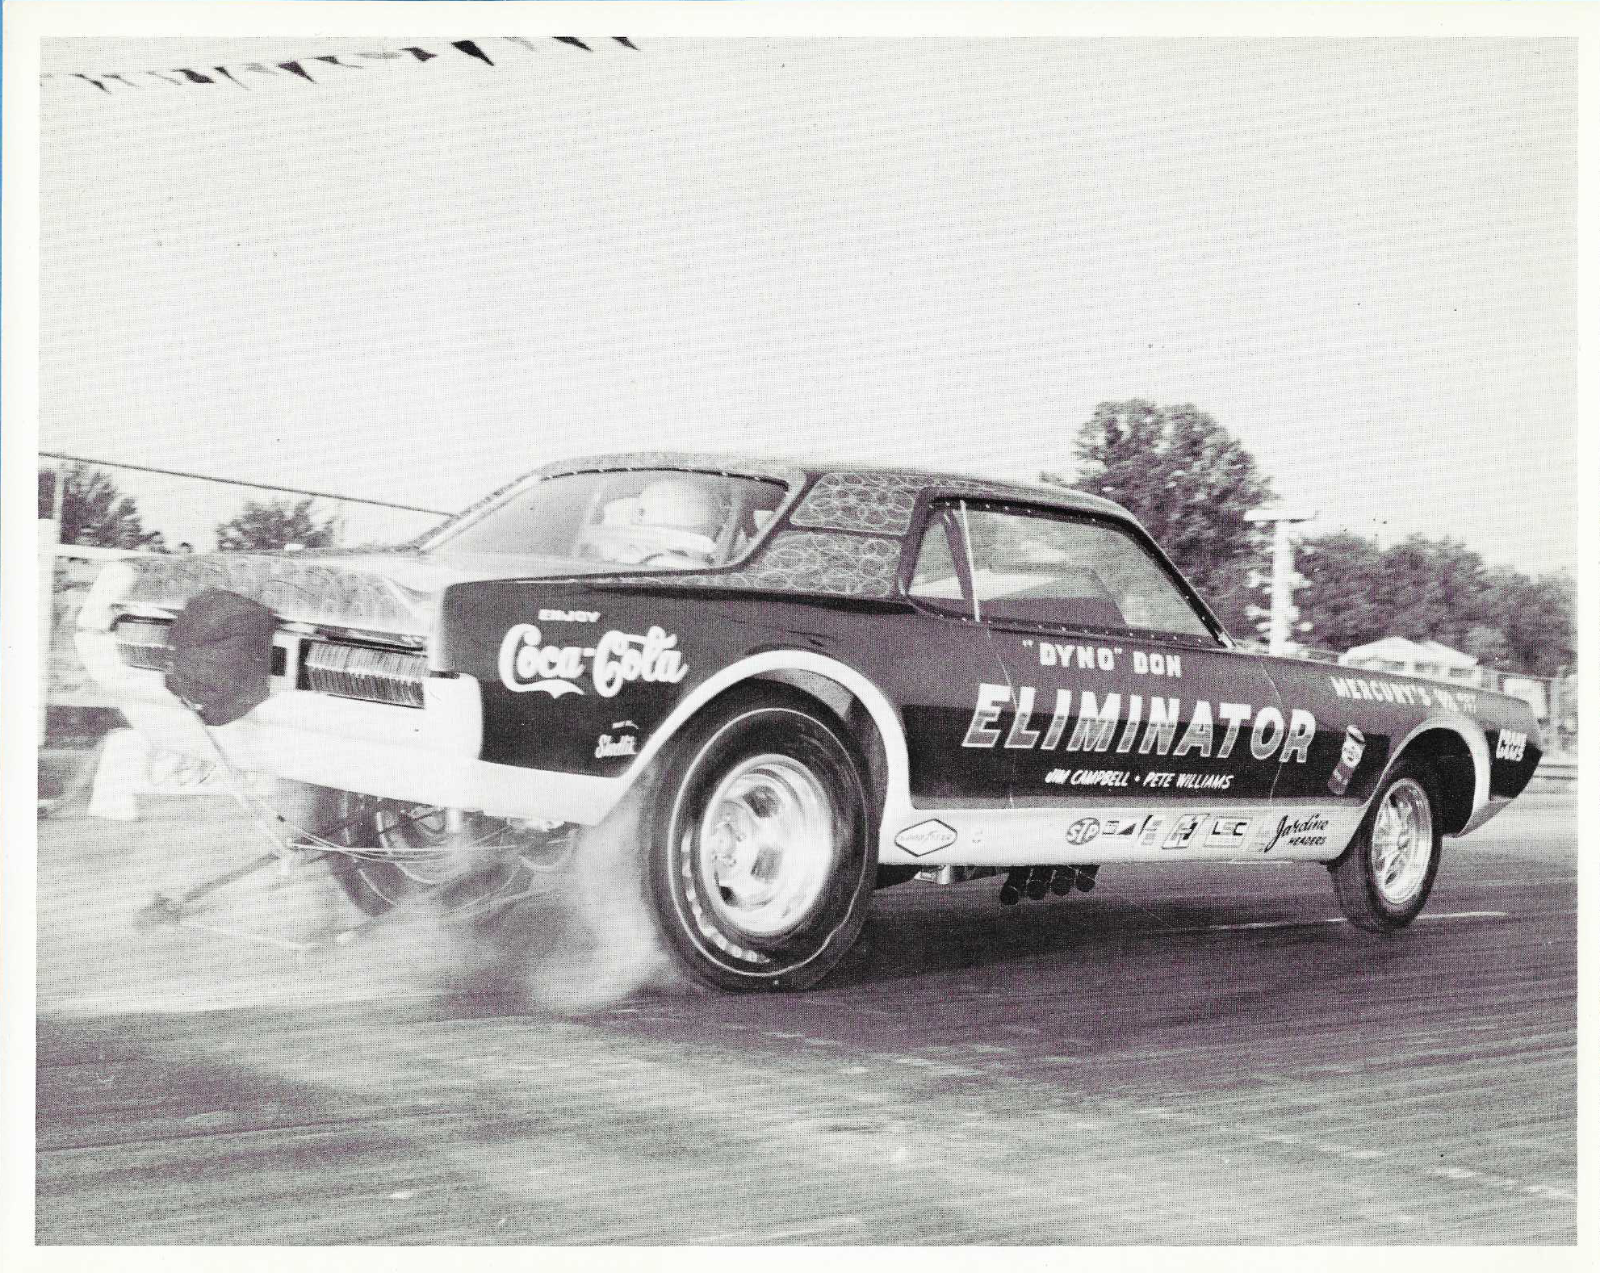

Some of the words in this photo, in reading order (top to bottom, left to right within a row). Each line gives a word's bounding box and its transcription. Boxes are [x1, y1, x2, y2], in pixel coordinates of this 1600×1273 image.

[538, 609, 601, 623] ENJOY
[498, 623, 689, 699] Coca-Cola
[1133, 651, 1182, 679] DON
[961, 683, 1317, 763] ELIMINATOR
[1070, 770, 1131, 787] CAMPBELL
[1142, 772, 1176, 788] PETE
[1175, 773, 1234, 790] WILLIAMS
[1066, 818, 1099, 844] STP
[1263, 813, 1329, 853] Jardine
